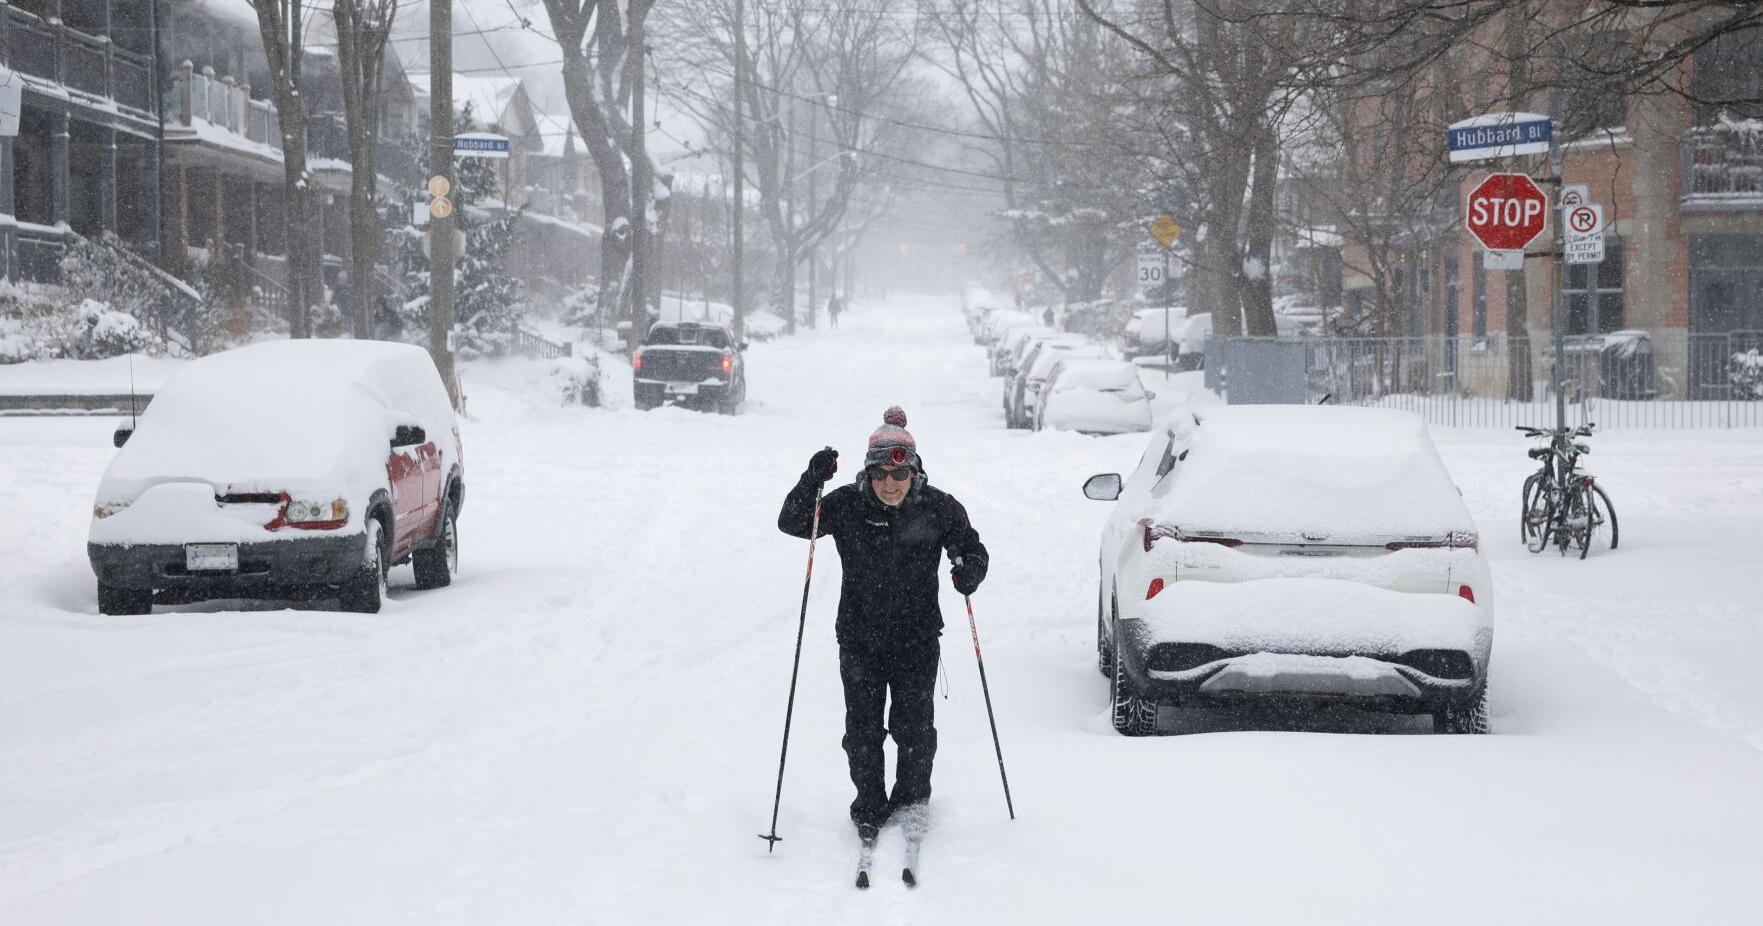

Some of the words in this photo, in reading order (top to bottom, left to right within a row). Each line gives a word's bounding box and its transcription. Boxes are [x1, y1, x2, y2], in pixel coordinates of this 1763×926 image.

[1457, 125, 1520, 146] Hubbard
[1529, 126, 1540, 139] Bl
[1472, 197, 1541, 227] STOP
[1570, 243, 1596, 252] EXCEPT
[1567, 253, 1575, 261] BY
[1577, 252, 1601, 260] PERMIT
[1140, 267, 1161, 281] 30
